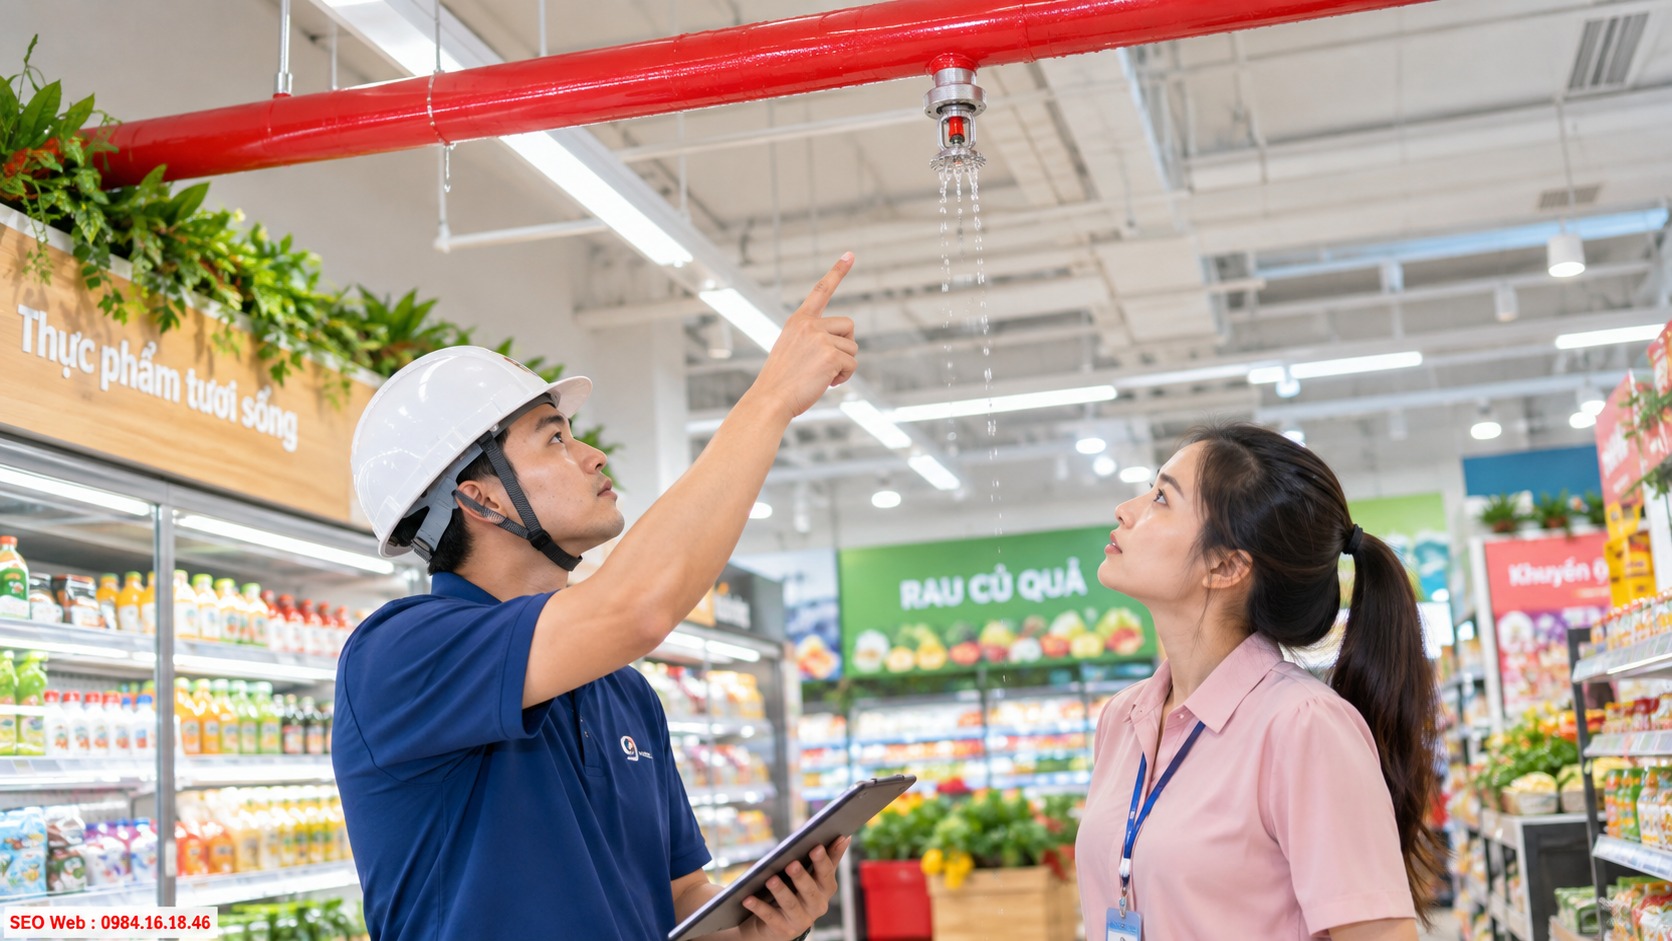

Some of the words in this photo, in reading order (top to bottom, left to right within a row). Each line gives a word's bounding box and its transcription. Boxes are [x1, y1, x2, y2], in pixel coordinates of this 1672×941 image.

[17, 303, 96, 379] Thực
[99, 340, 181, 404] phẩm
[185, 368, 237, 423] tươi
[241, 385, 298, 453] sống
[900, 575, 964, 611] RAU
[968, 562, 1014, 604] CỦ
[1017, 556, 1088, 603] QUẢ
